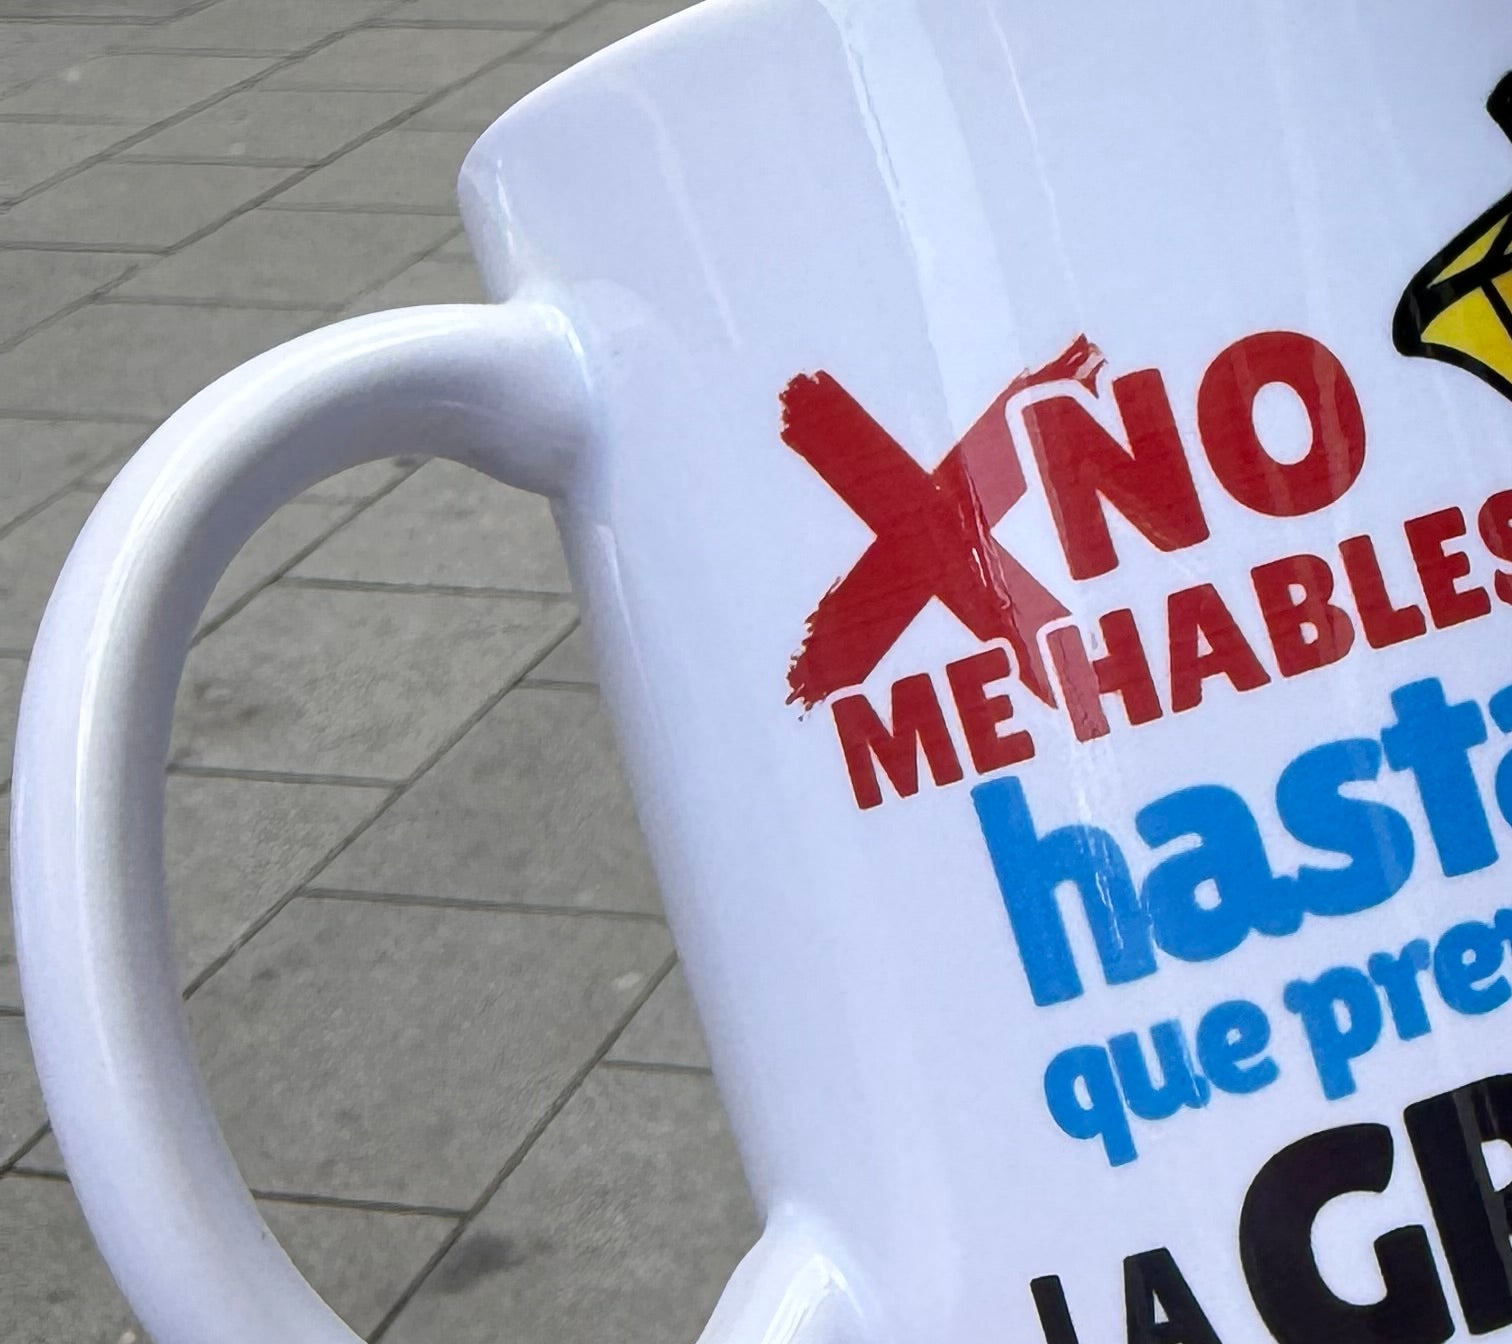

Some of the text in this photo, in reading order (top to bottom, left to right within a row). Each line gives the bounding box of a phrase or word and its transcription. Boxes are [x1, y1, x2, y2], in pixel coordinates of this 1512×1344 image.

[1022, 330, 1367, 581] NO
[832, 647, 1035, 810] ME
[1043, 999, 1278, 1168] que
